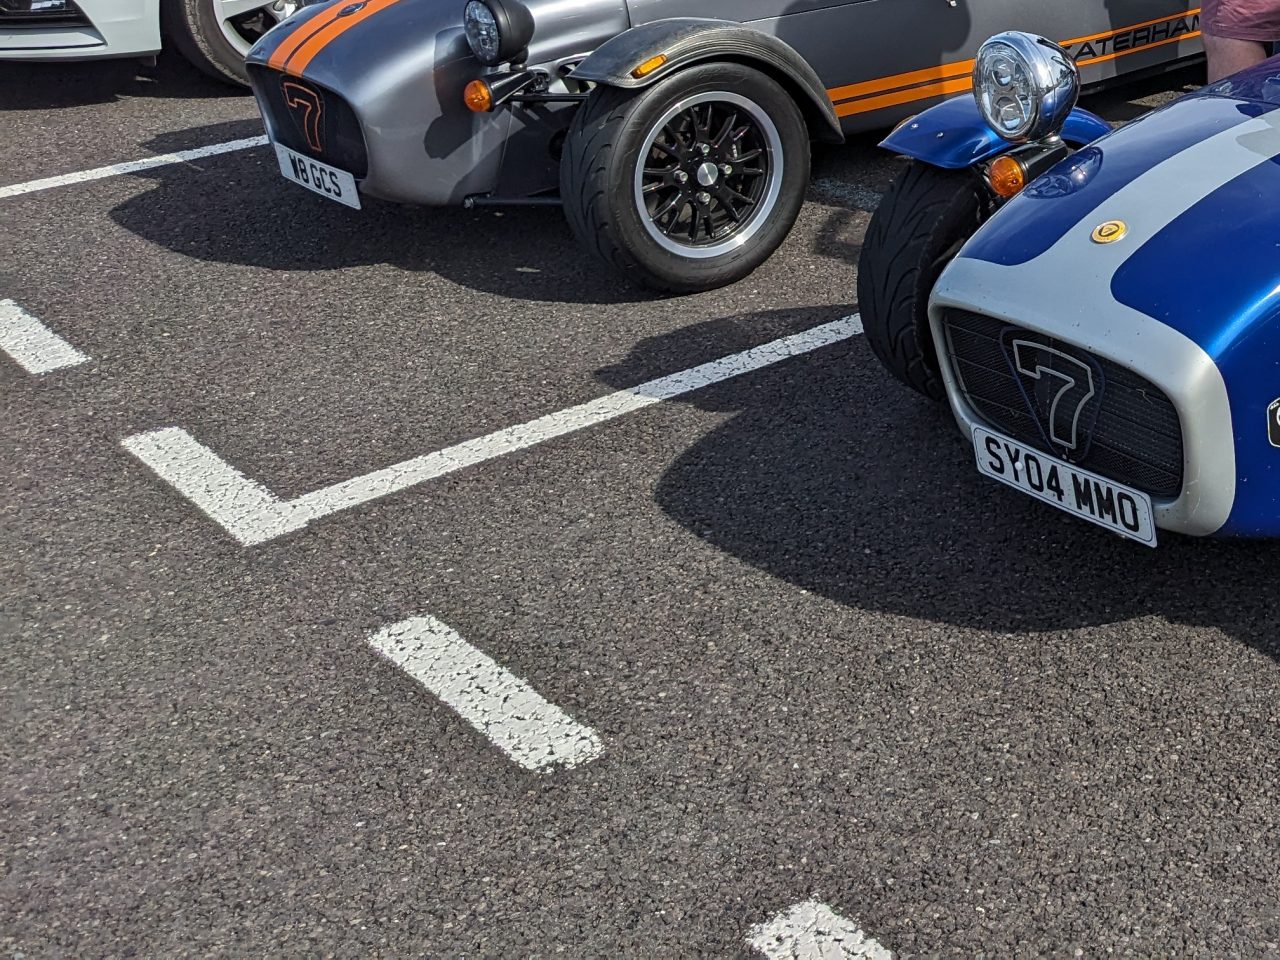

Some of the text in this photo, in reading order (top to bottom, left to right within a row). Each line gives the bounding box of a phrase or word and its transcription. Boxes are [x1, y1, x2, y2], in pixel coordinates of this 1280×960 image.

[283, 82, 322, 152] 7
[288, 152, 342, 198] W8 GCS
[1012, 339, 1095, 450] 7
[985, 435, 1140, 533] SY04 MMO
